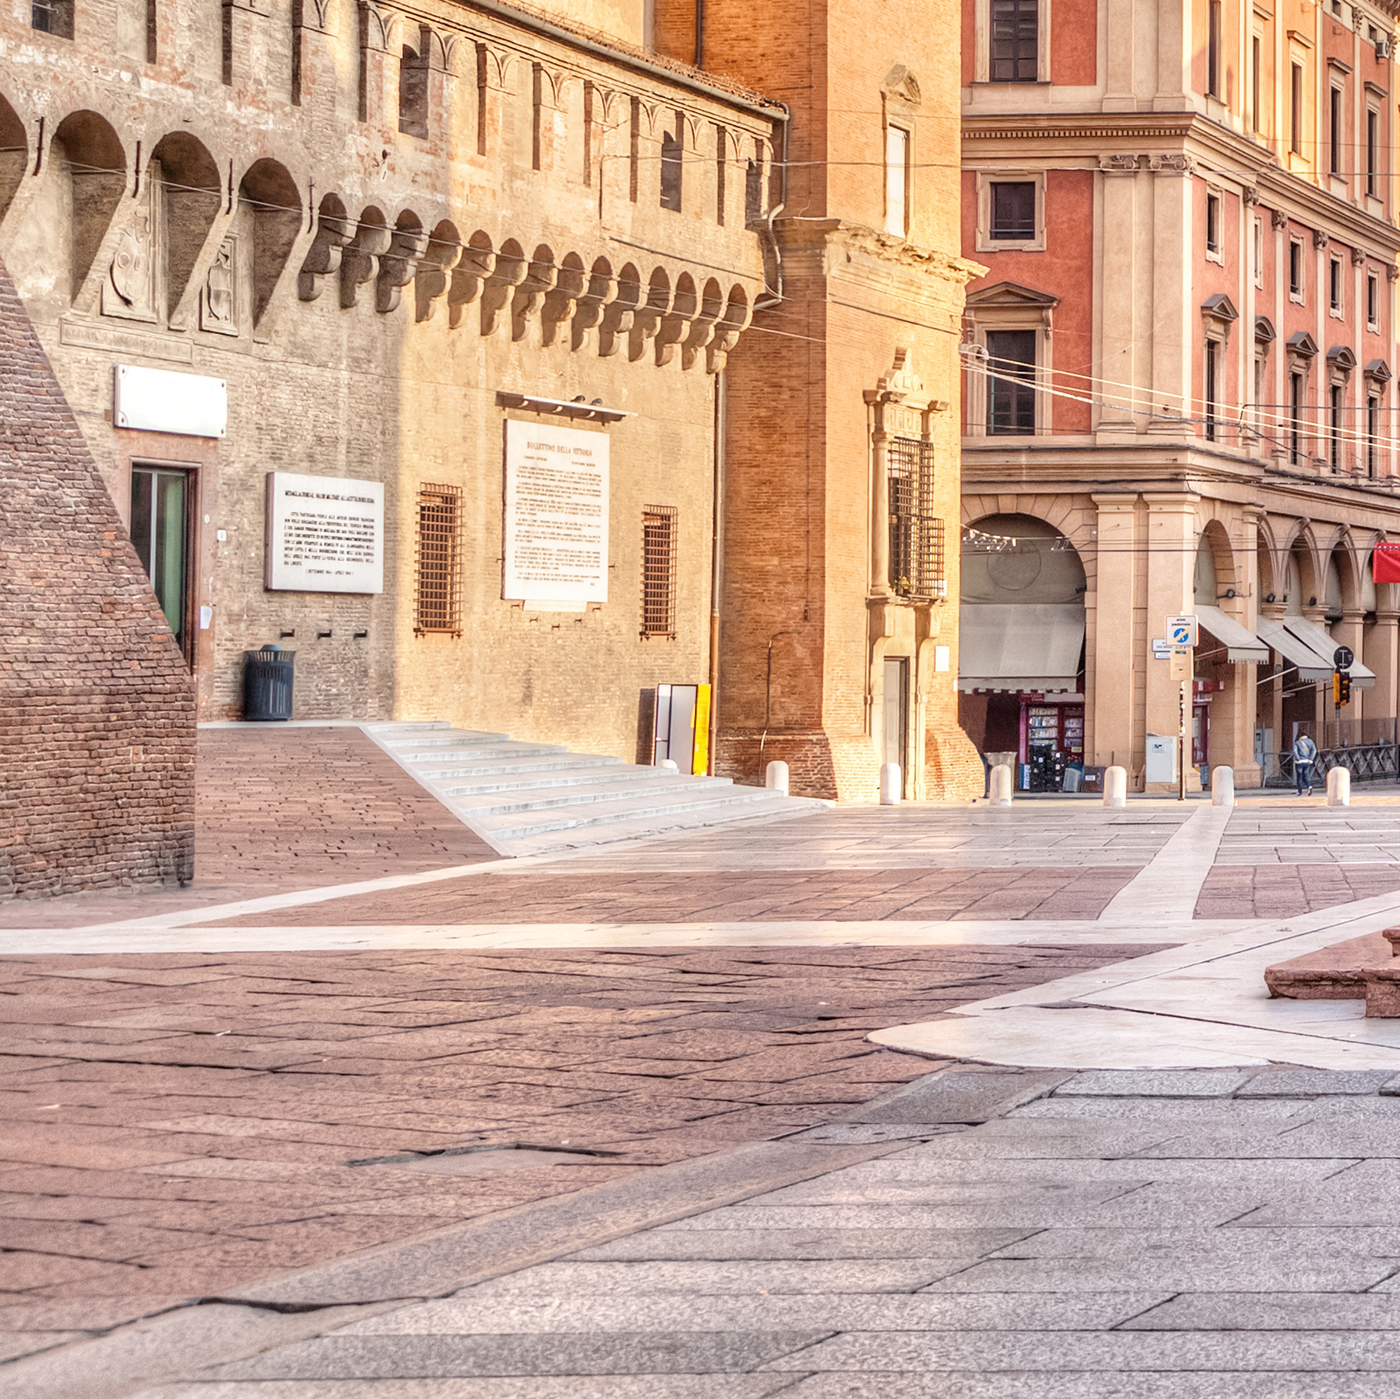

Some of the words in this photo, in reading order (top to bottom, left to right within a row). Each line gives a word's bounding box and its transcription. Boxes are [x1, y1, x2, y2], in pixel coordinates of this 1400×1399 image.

[526, 441, 556, 453] BOLLETTINO
[557, 444, 571, 454] DELLA
[573, 447, 593, 457] VITTORIA
